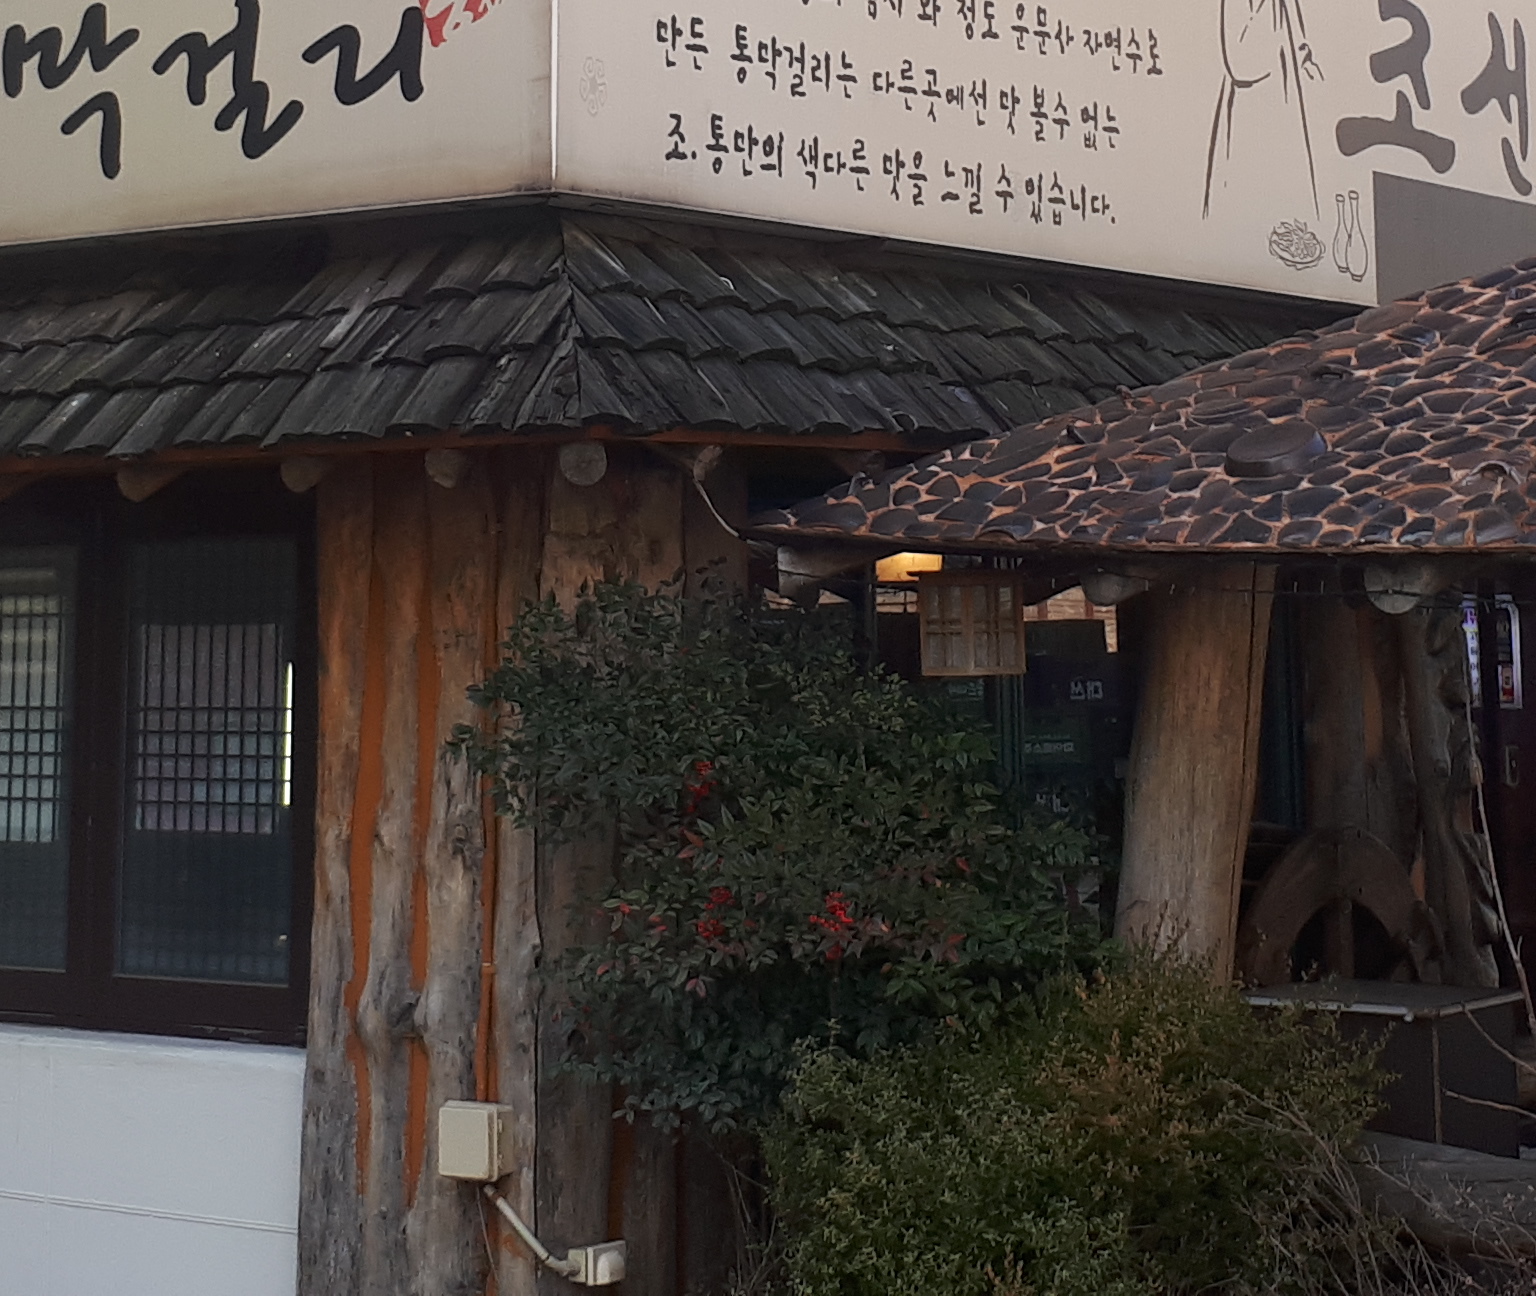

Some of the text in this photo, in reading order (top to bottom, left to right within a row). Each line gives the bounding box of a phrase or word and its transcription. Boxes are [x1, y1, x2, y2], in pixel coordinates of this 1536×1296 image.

[656, 14, 709, 71] 만든
[730, 24, 858, 99] 통막걸리는
[999, 84, 1021, 135] 맛
[1080, 101, 1121, 151] 없는
[1010, 2, 1074, 55] 운문사
[1082, 26, 1164, 75] 자연수로
[797, 136, 871, 191] 색다른
[882, 148, 928, 206] 맛을
[941, 159, 984, 215] 느낄
[994, 163, 1015, 213] 수
[1025, 171, 1116, 226] 있습니다.
